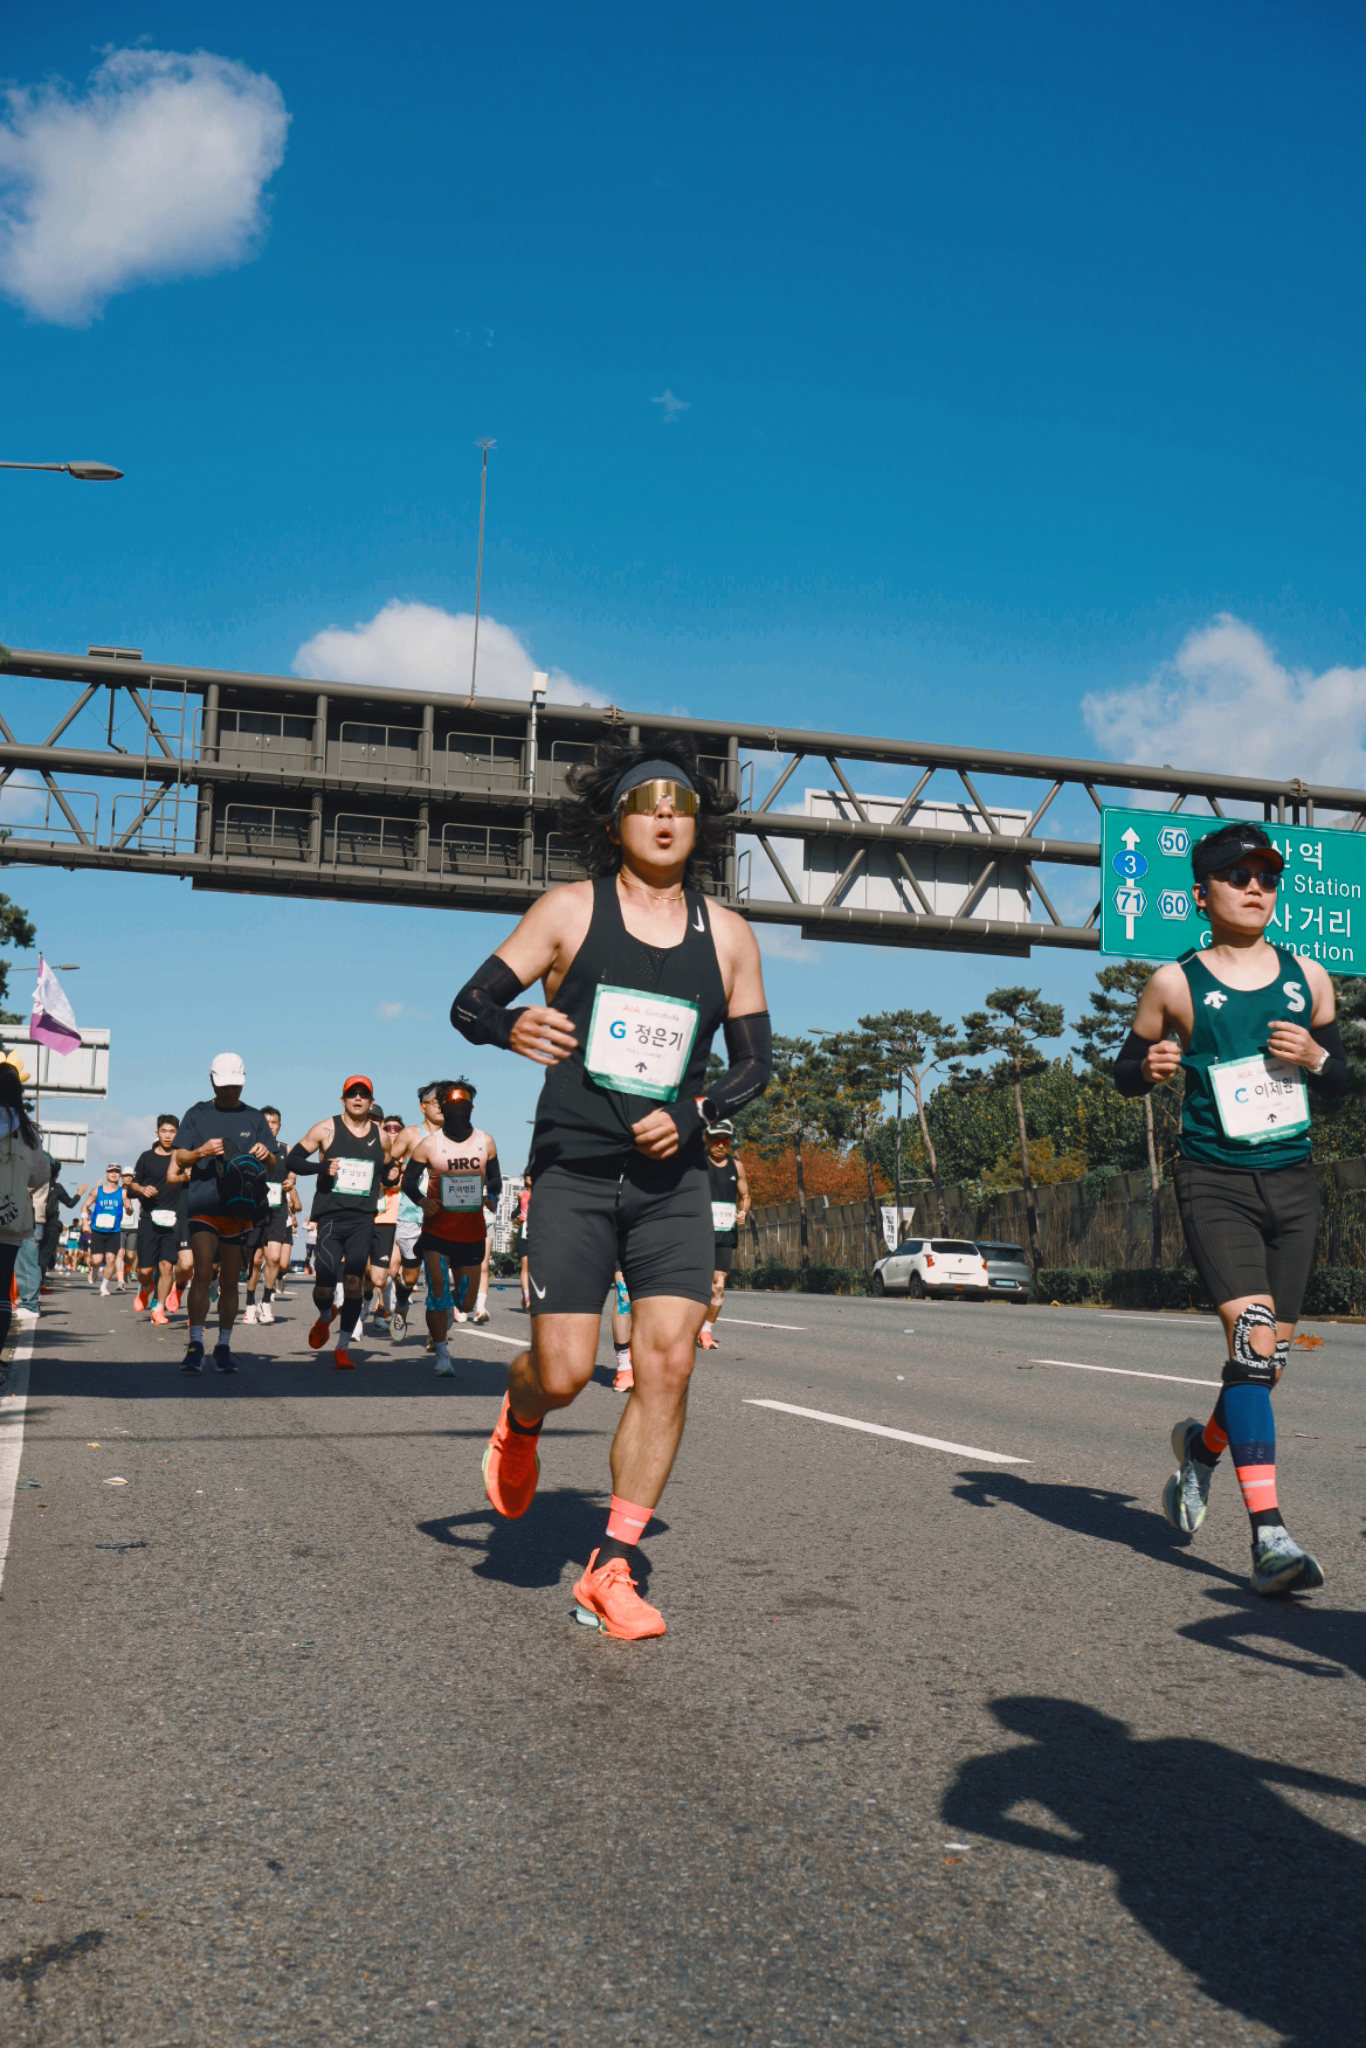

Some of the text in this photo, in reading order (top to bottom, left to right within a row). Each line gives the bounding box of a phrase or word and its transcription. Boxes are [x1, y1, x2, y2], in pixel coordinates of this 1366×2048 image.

[1163, 831, 1187, 852] 50
[1124, 855, 1137, 875] 3
[1294, 874, 1361, 899] Station
[1120, 891, 1141, 911] 71
[1163, 895, 1187, 914] 60
[1283, 981, 1306, 1012] S
[609, 1020, 684, 1052] G 정은기
[1234, 1087, 1250, 1104] C
[446, 1157, 481, 1170] HRC
[449, 1185, 455, 1193] F
